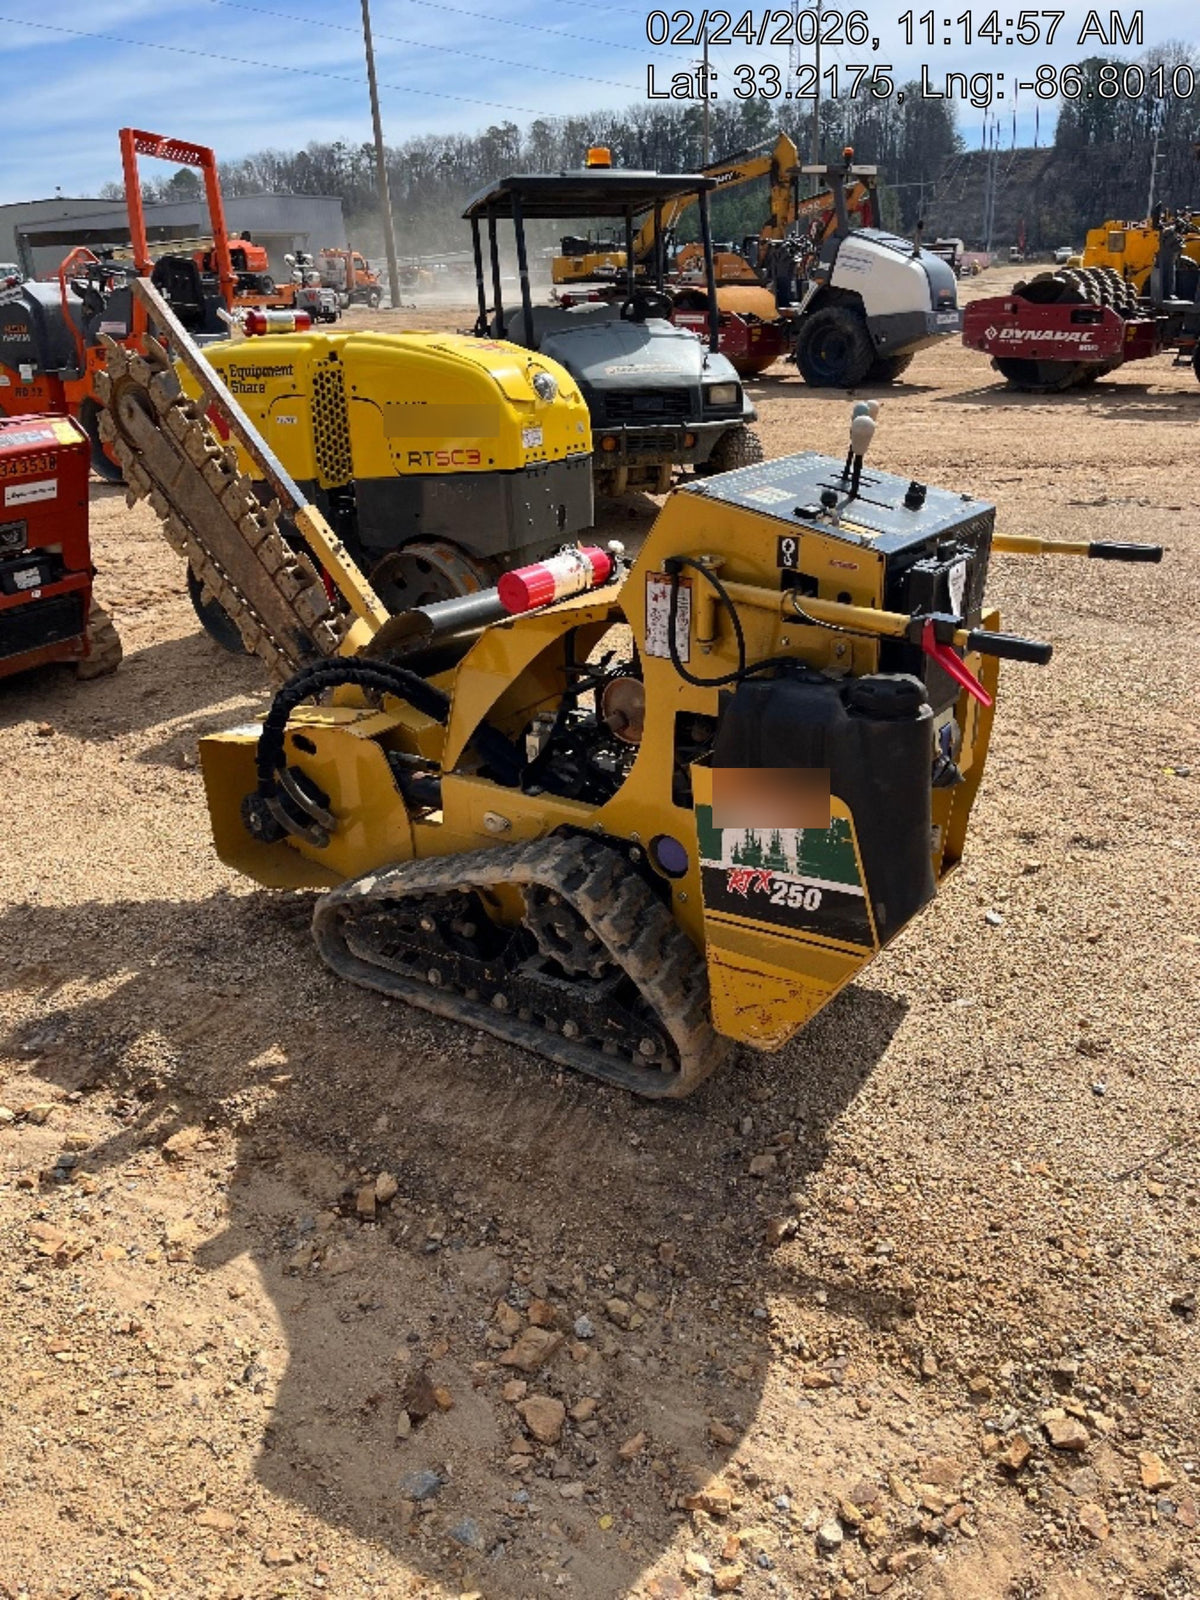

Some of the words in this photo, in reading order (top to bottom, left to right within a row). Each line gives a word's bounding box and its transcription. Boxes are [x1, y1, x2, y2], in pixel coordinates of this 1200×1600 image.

[998, 328, 1095, 343] DYNAPAC
[229, 364, 294, 381] Equipment
[231, 381, 266, 394] Share
[727, 867, 774, 898] RTX
[769, 881, 823, 911] 250
